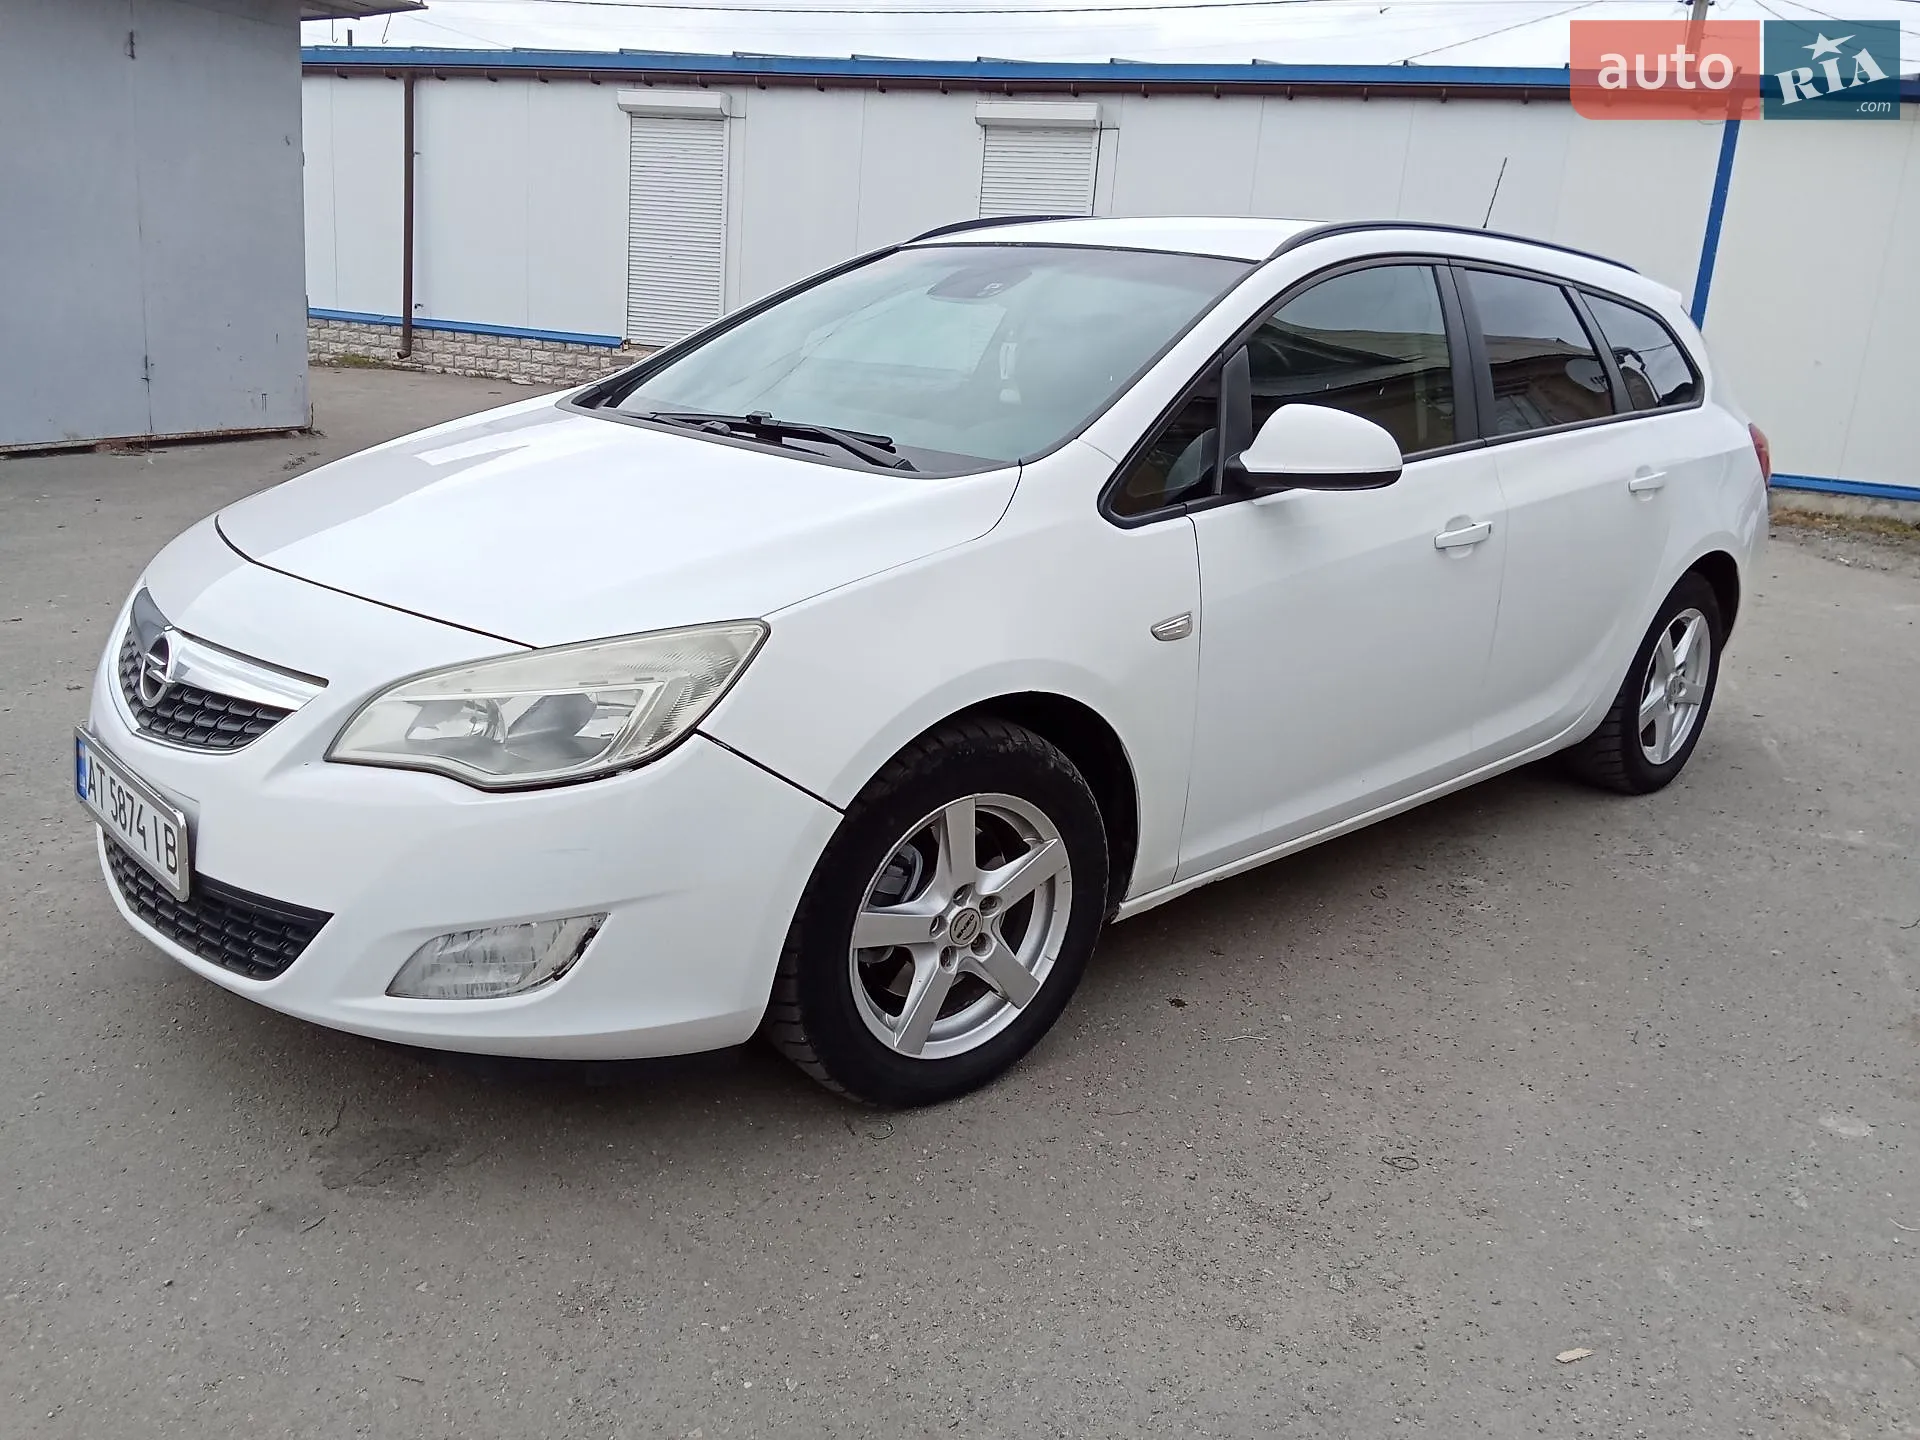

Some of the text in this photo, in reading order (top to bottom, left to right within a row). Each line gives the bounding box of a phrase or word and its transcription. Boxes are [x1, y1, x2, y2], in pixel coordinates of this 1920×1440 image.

[88, 756, 178, 875] AT 5874 IB
